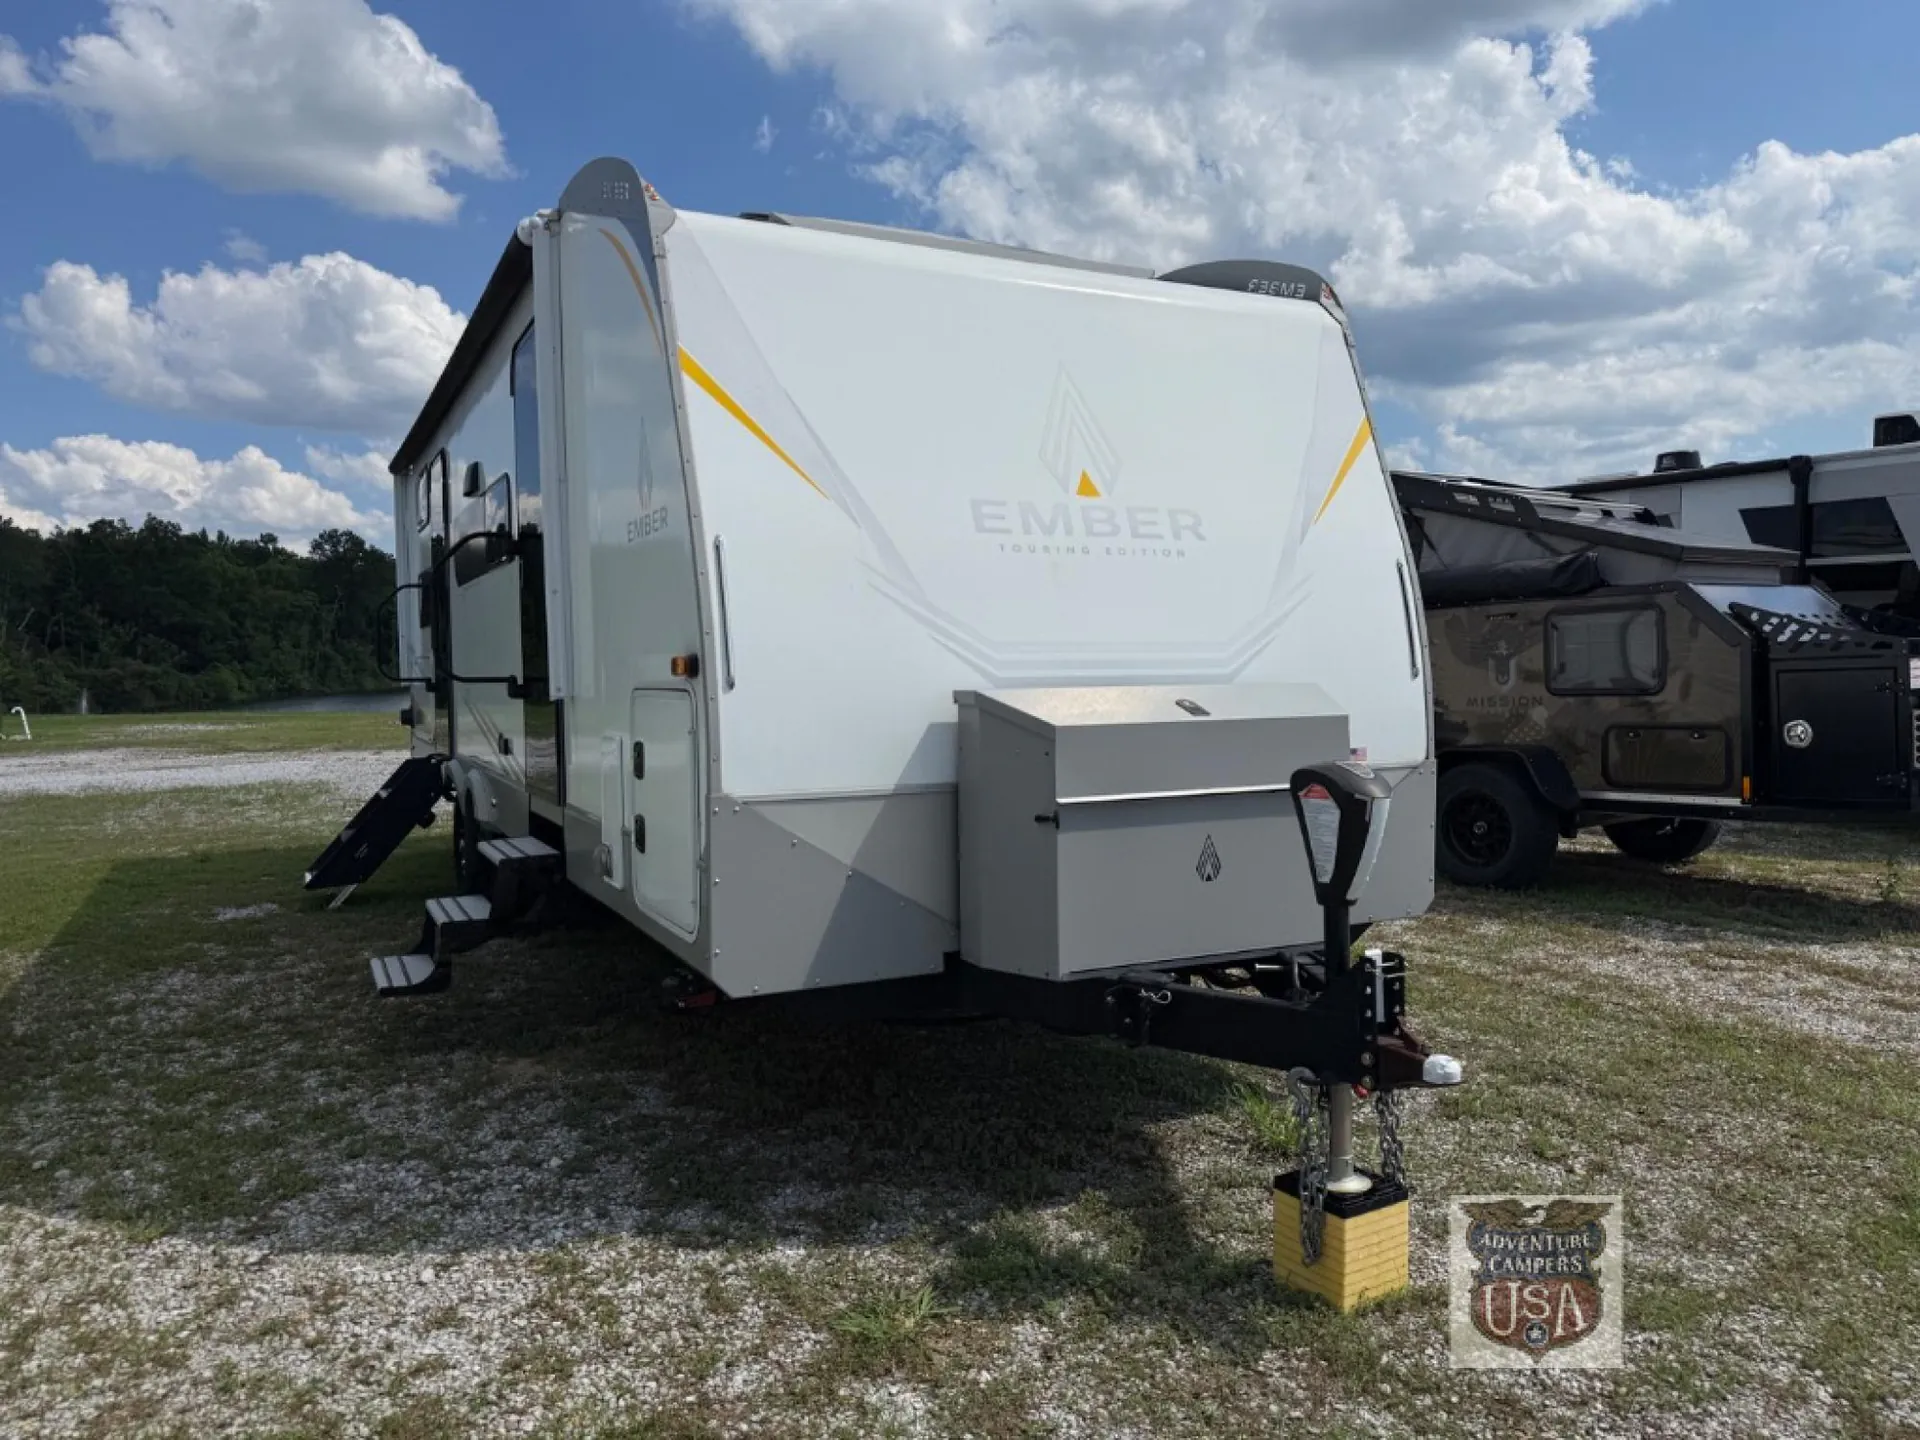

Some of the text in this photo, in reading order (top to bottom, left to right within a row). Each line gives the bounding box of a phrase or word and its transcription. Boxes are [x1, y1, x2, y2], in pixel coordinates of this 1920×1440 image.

[627, 506, 669, 544] EMBER
[969, 498, 1207, 542] EMBER
[999, 543, 1186, 558] TOURING EDITION
[1466, 695, 1544, 708] MISSION
